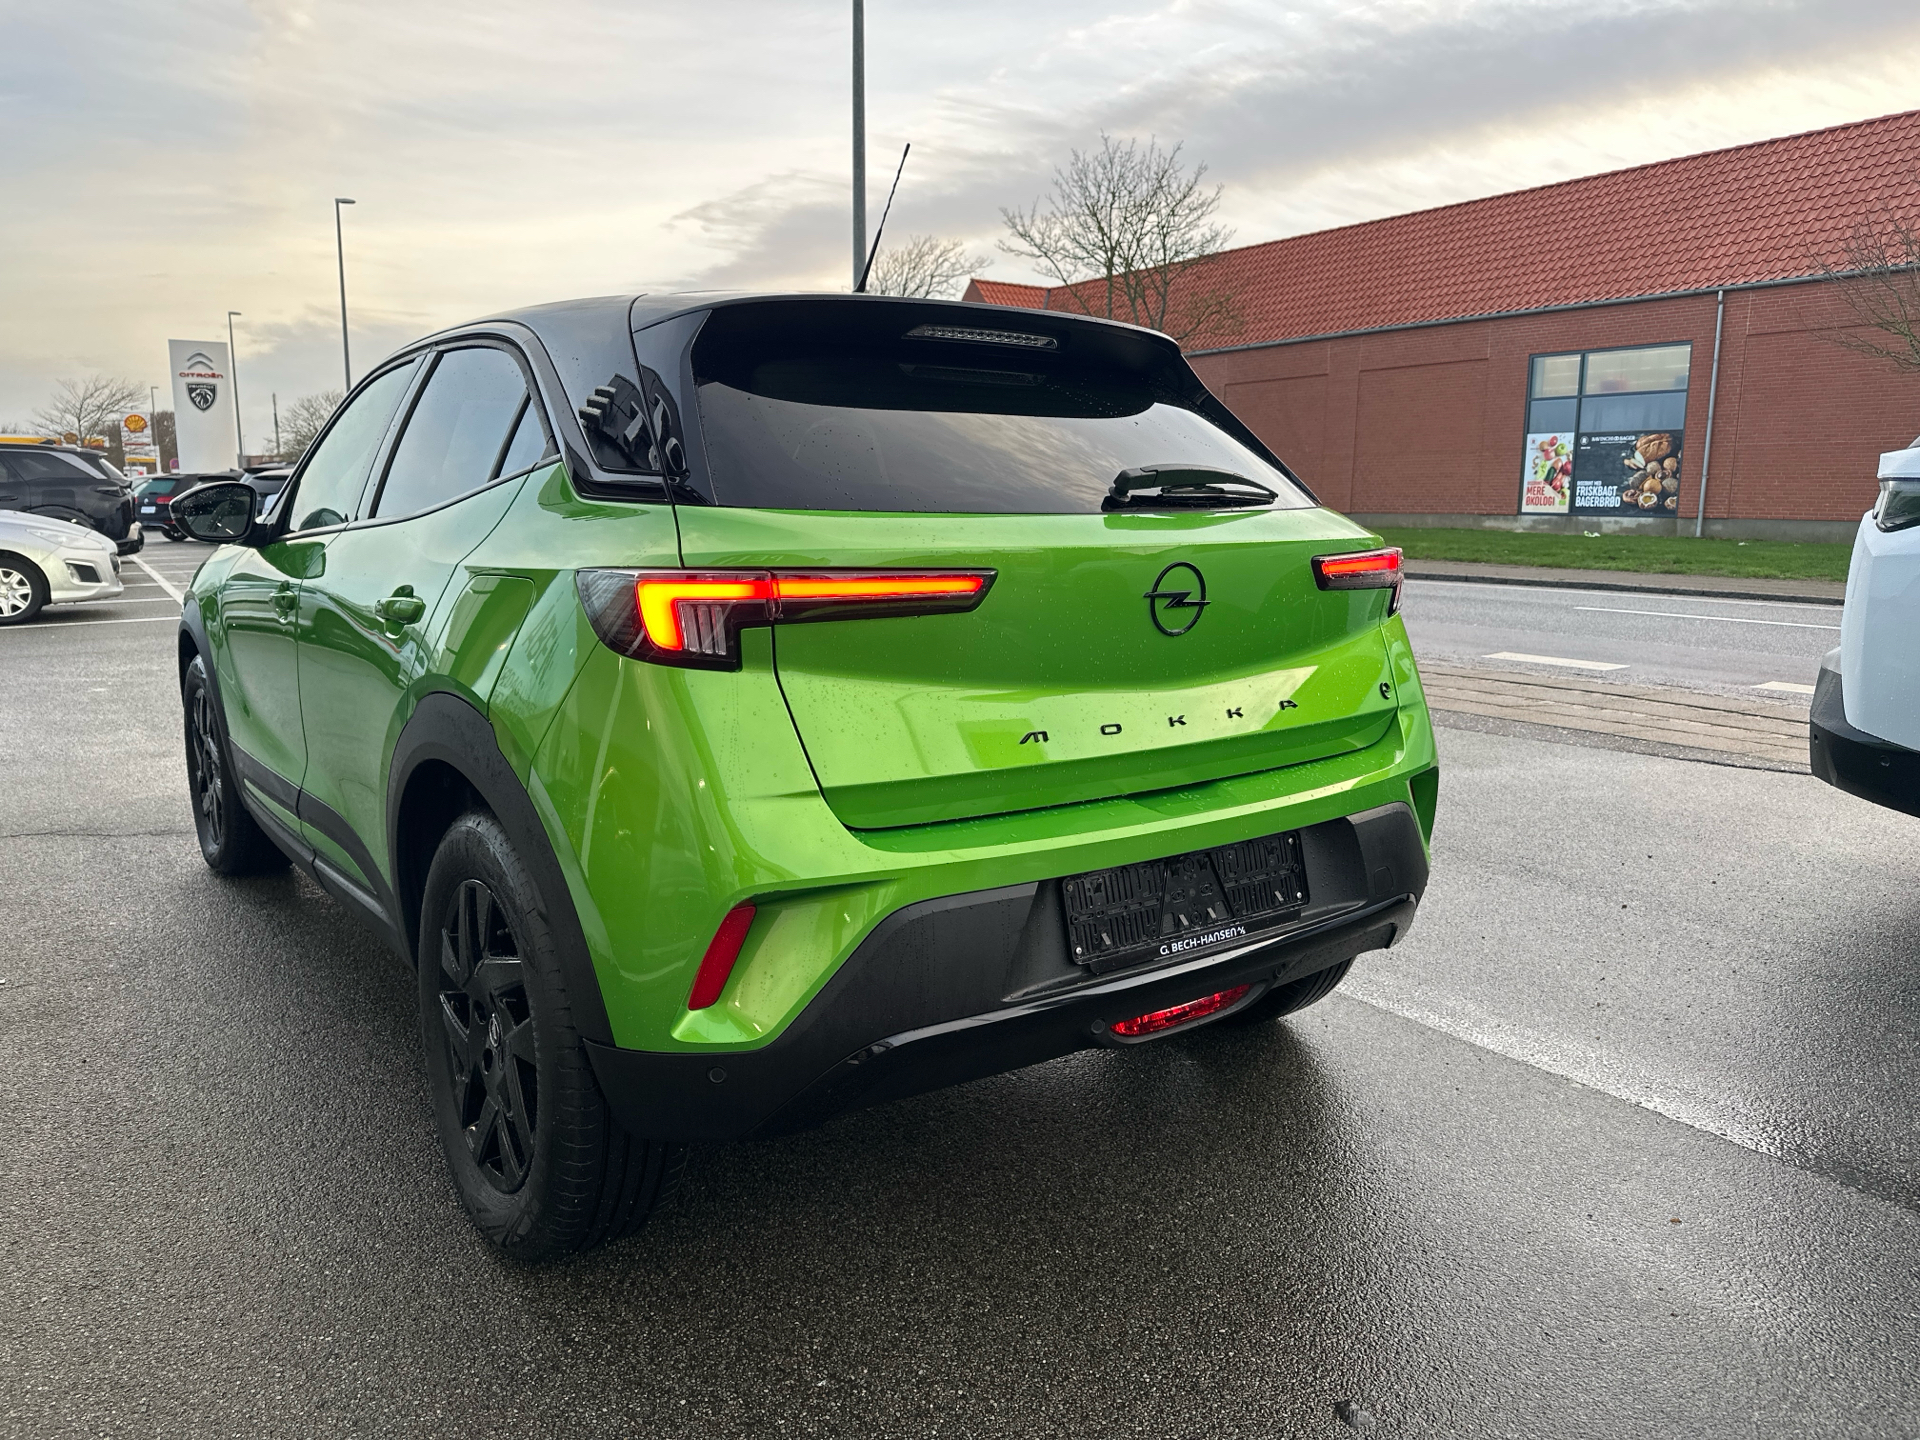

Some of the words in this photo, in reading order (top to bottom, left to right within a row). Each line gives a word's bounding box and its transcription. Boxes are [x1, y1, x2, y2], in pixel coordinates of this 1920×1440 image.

[1526, 486, 1545, 496] MERE
[1576, 485, 1618, 497] FRISKBAGT
[1525, 496, 1556, 506] ØKOLOGI
[1575, 496, 1621, 507] BAGERBRØD
[1019, 699, 1299, 745] MOKKA
[1159, 944, 1170, 956] G.
[1171, 927, 1238, 953] BECH-HANSEN
